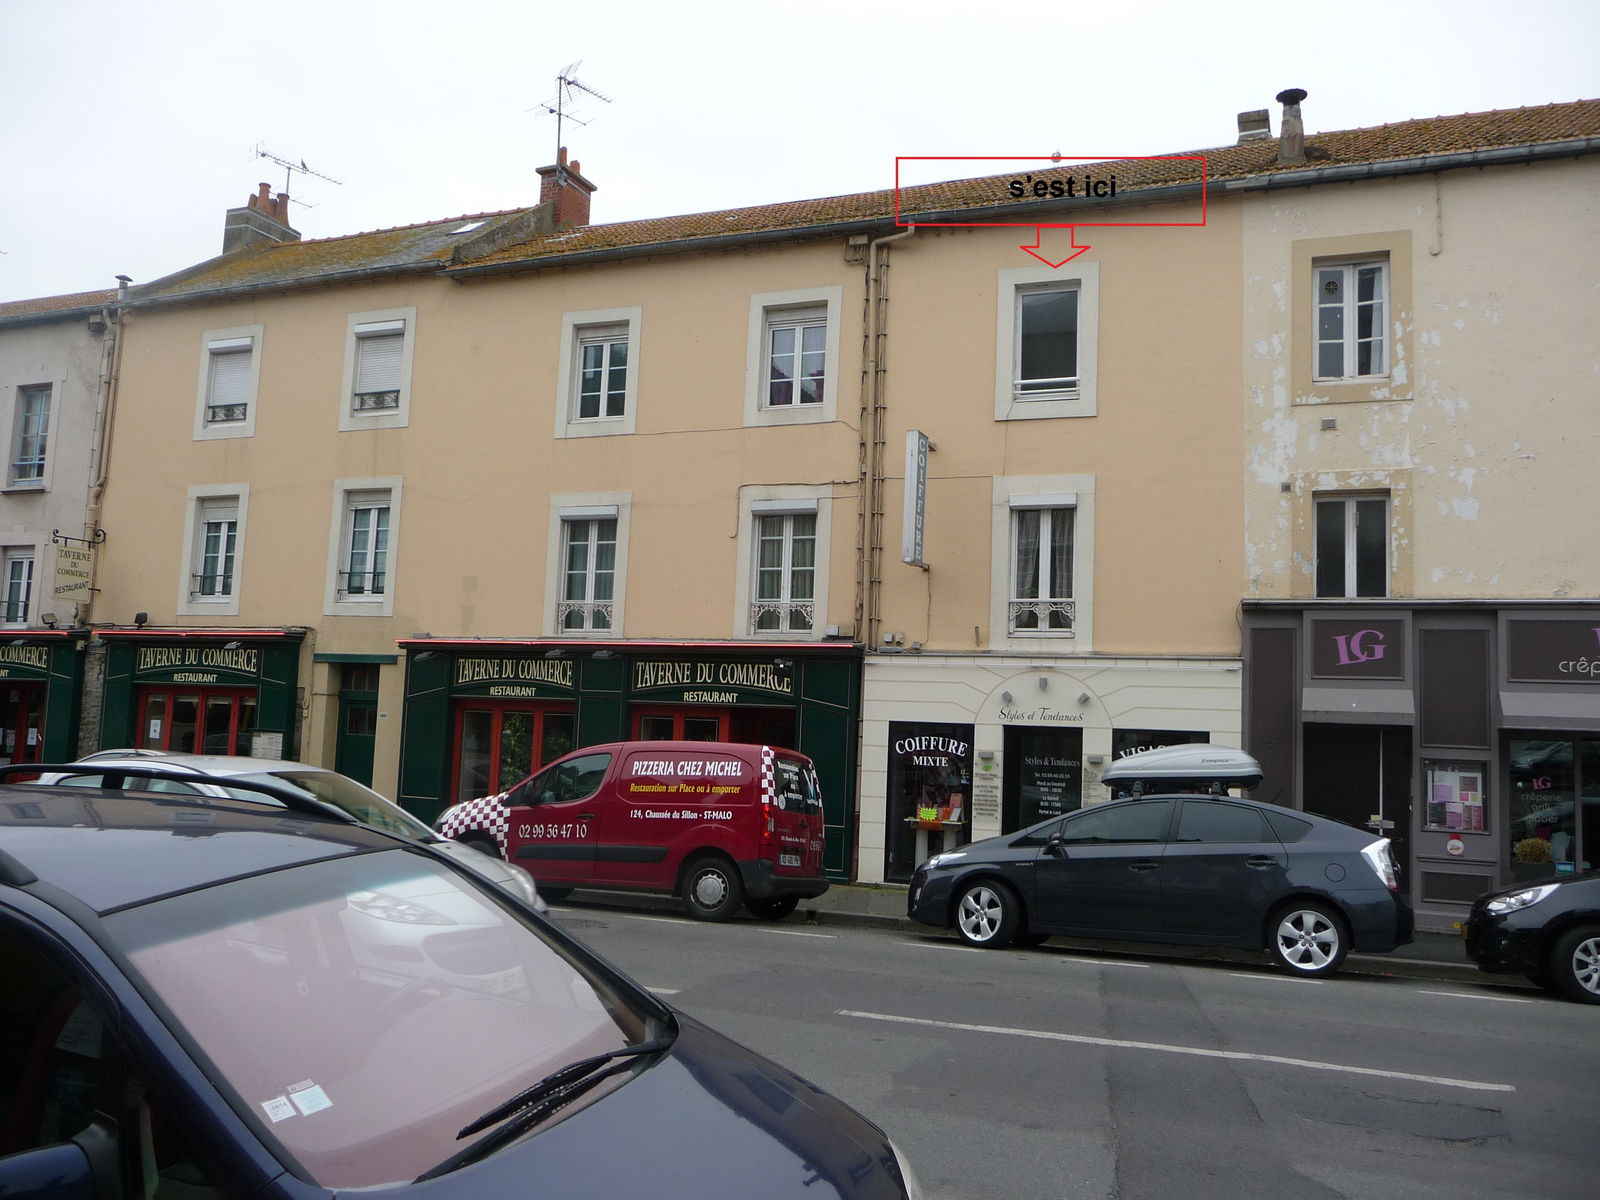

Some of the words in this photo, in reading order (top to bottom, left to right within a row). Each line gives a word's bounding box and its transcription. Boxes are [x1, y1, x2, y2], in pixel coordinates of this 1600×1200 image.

[60, 549, 91, 561] TAVERNE
[57, 567, 90, 578] COMMERCE
[54, 581, 89, 594] RESTAURANT
[139, 647, 182, 669] TAVERNE
[184, 648, 199, 665] DU
[202, 648, 258, 672] COMMERCE
[173, 672, 218, 683] RESTAURANT
[458, 659, 500, 683] TAVERNE
[502, 659, 516, 678] DU
[519, 659, 573, 686] COMMERCE
[636, 662, 691, 688] TAVERNE
[696, 663, 714, 683] DU
[489, 686, 537, 697] RESTAURANT
[683, 691, 739, 703] RESTAURANT
[999, 705, 1025, 722] Styles
[1028, 711, 1036, 720] et
[1039, 707, 1085, 722] Tendances
[895, 736, 968, 757] COIFFURE
[912, 755, 949, 767] MIXTE
[1024, 756, 1043, 768] Styles
[632, 761, 674, 776] PIZZERIA
[677, 761, 702, 776] CHEZ
[705, 761, 742, 777] MICHEL
[630, 783, 667, 793] Restauration
[667, 785, 677, 793] sur
[679, 783, 695, 793] Place
[706, 784, 710, 793] à
[712, 785, 741, 794] emporter
[1521, 793, 1562, 804] crêperie
[630, 809, 644, 820] 124,
[645, 810, 671, 819] Chaussée
[672, 810, 680, 819] du
[681, 810, 698, 819] Sillon
[704, 811, 732, 820] ST-MALO
[518, 824, 531, 838] 02
[532, 824, 545, 838] 99
[546, 824, 559, 838] 56
[560, 824, 573, 838] 47
[575, 824, 587, 838] 10
